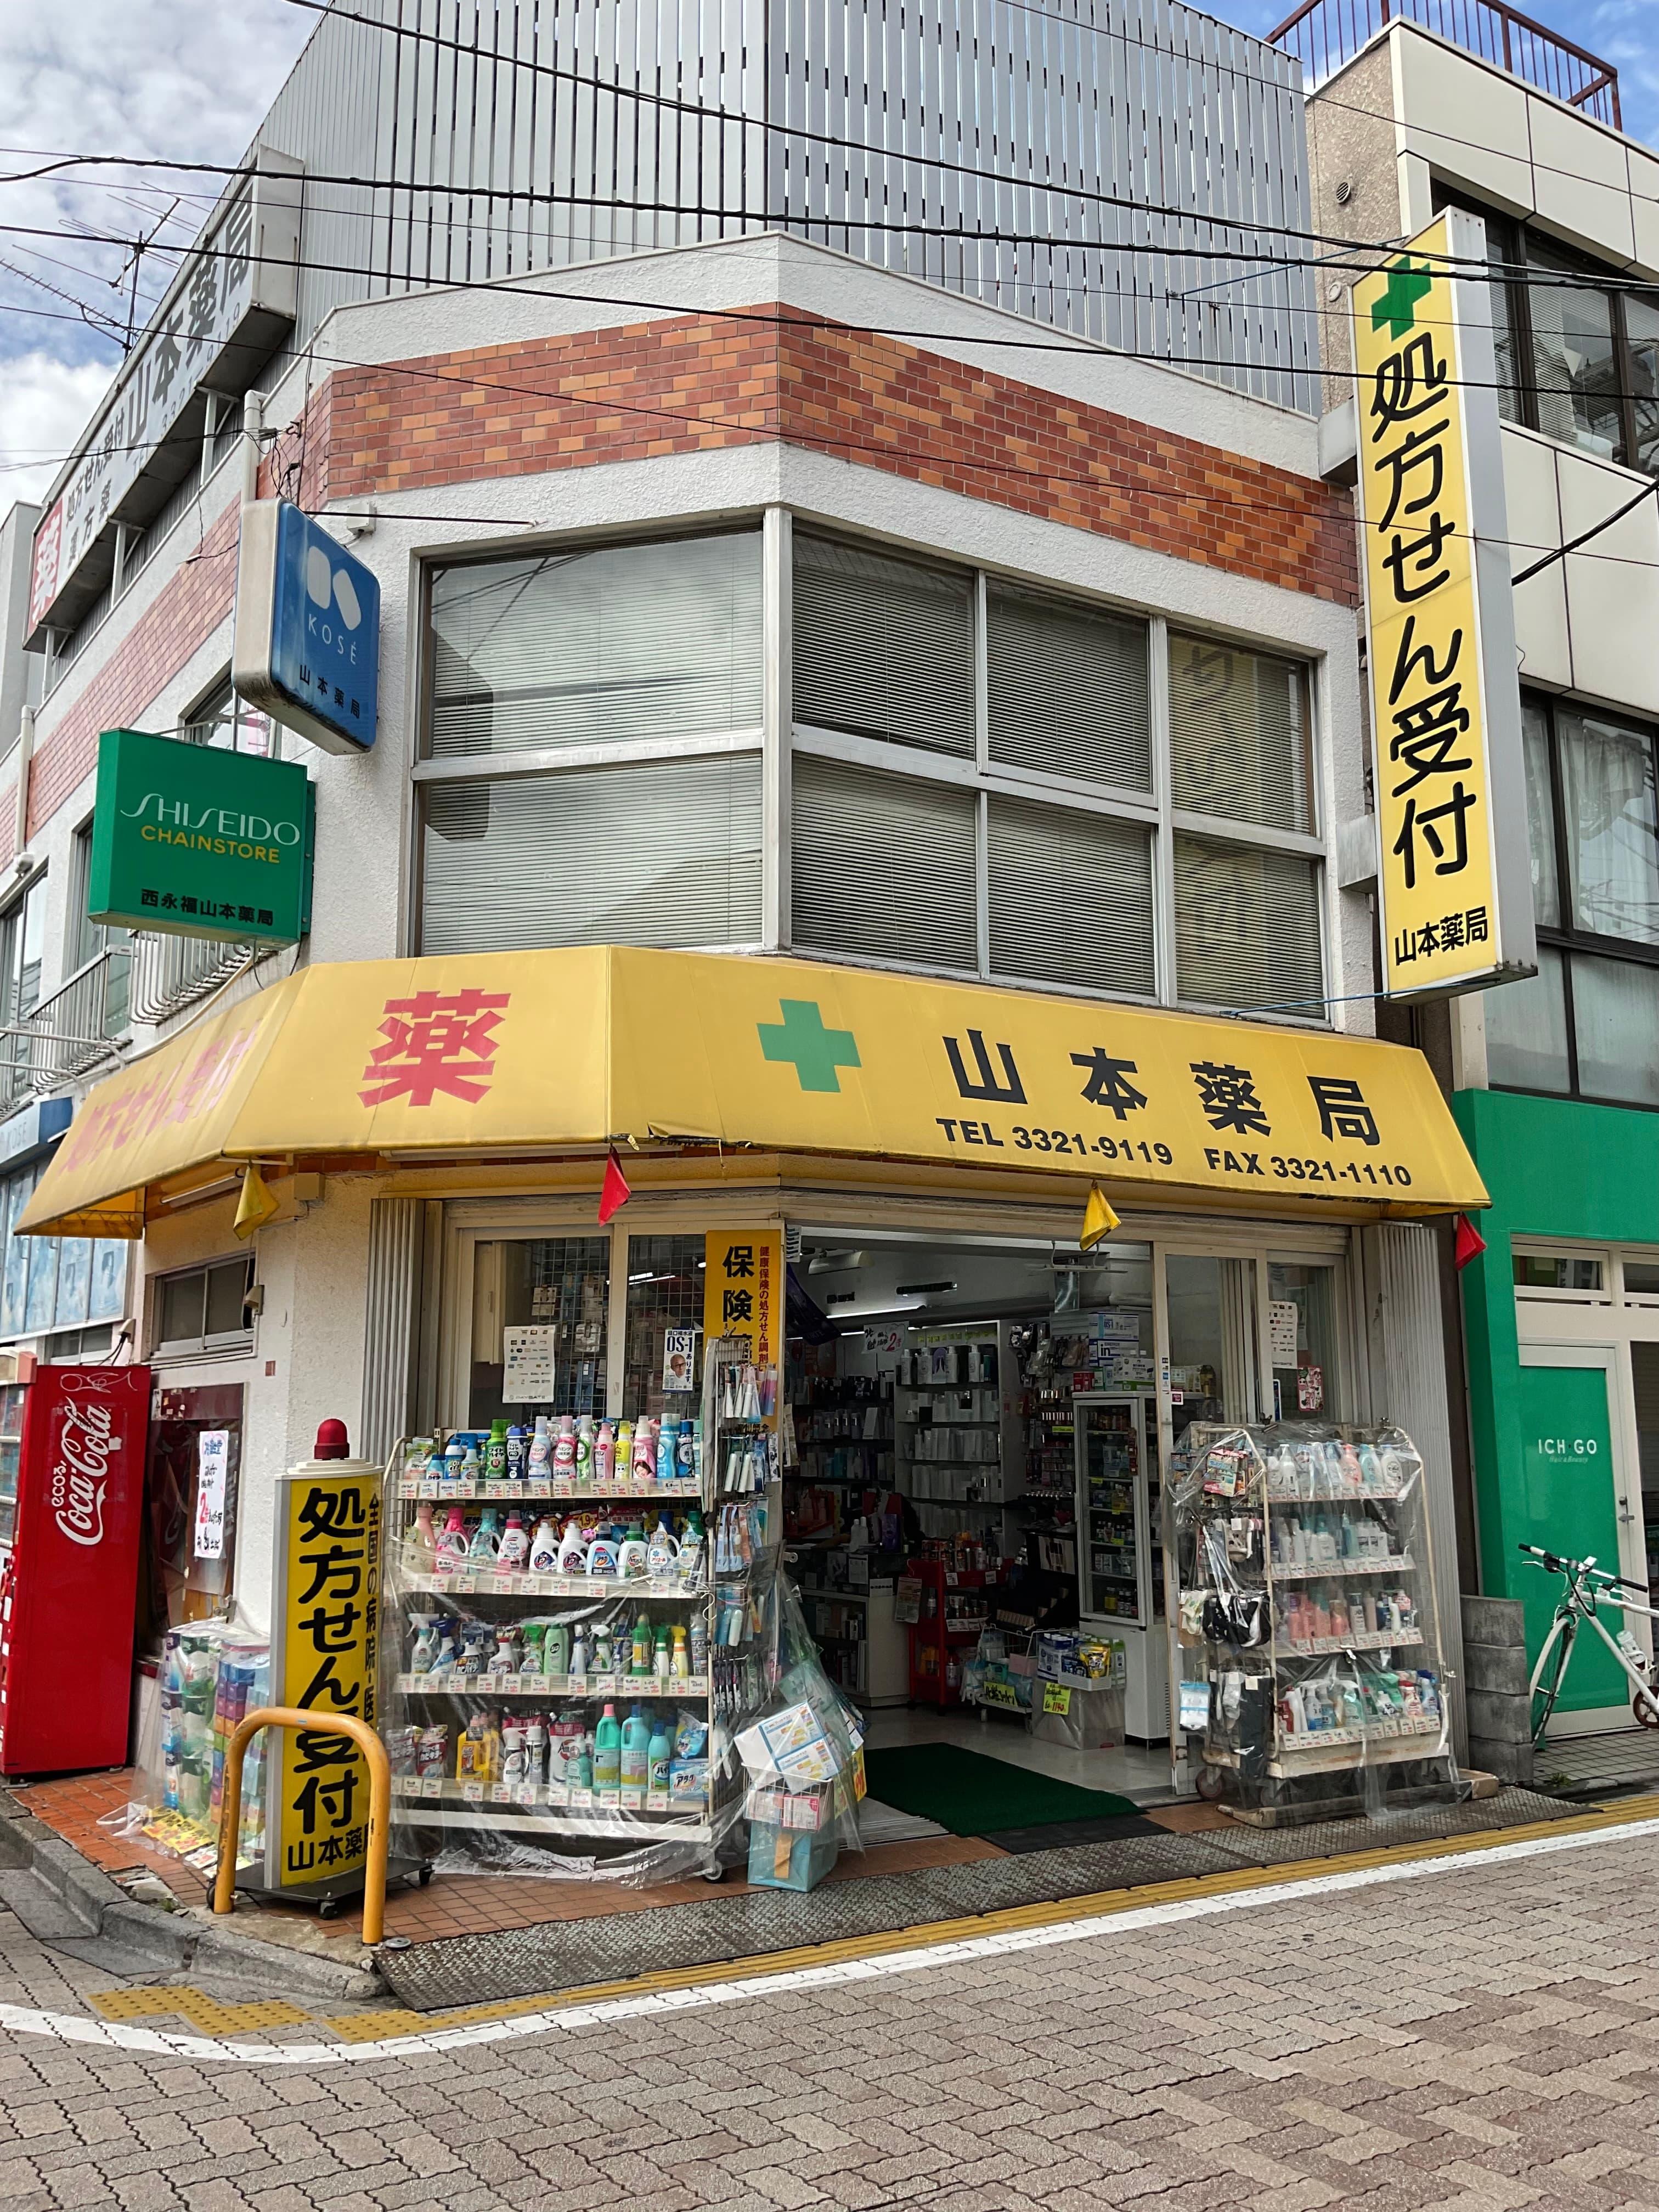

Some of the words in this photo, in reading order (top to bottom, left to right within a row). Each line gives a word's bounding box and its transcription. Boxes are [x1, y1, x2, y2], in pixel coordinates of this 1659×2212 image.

[126, 181, 253, 461] 山本薬局
[1369, 331, 1477, 889] 処方せん受付
[299, 664, 360, 719] 山本薬局
[120, 793, 300, 846] SHISEIDO
[140, 825, 280, 864] CHAINSTORE
[140, 888, 274, 927] 西永福山本薬局
[1394, 906, 1489, 967] 山本薬局
[357, 989, 511, 1108] 薬
[941, 1028, 1381, 1147] 山本薬局
[935, 1118, 1005, 1148] TEL
[1012, 1126, 1173, 1166] 3321-9119
[1204, 1148, 1265, 1177] FAX
[1270, 1156, 1413, 1187] 3321-1110
[667, 1336, 693, 1352] OS-1
[55, 1396, 112, 1545] Coca-Cola
